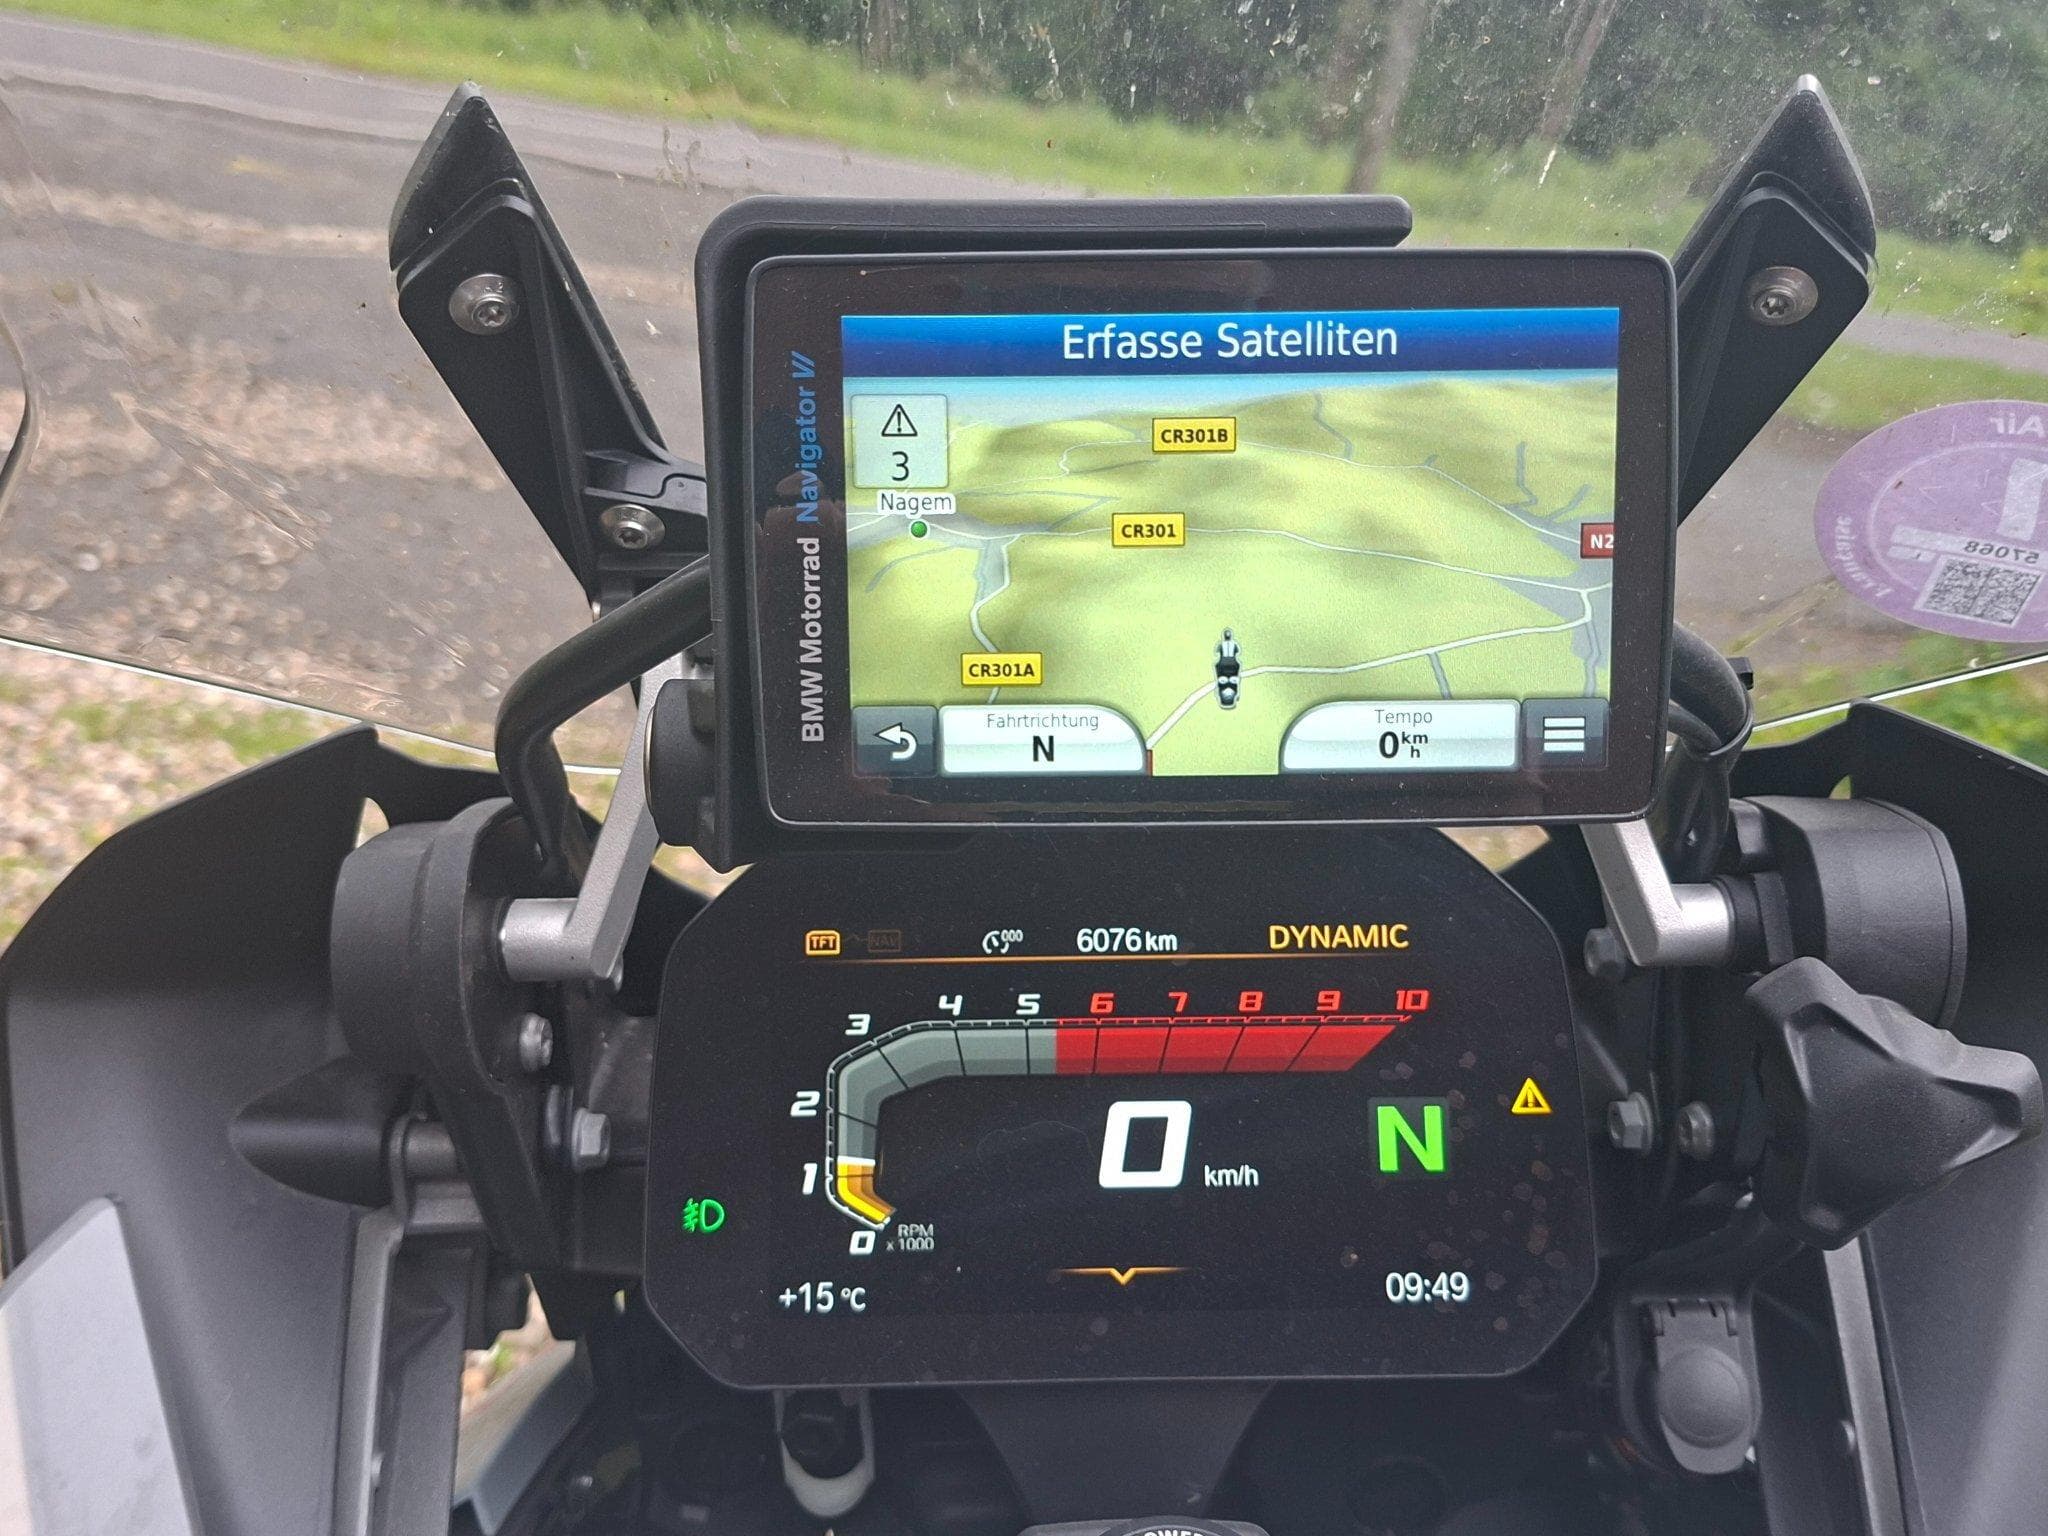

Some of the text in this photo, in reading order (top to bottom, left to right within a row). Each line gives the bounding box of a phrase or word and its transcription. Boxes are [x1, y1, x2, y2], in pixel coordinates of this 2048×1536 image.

[1063, 320, 1399, 362] Erfasse Satelliten
[1159, 426, 1229, 446] CR301B
[795, 385, 822, 523] Navigator
[892, 450, 910, 482] 3
[881, 493, 952, 515] Nagem
[1120, 521, 1177, 540] CR301
[797, 536, 823, 665] Motorrad
[967, 661, 1036, 680] CR301A
[800, 670, 825, 743] BMW
[1374, 709, 1433, 727] Tempo
[987, 713, 1099, 731] Fahrtrichtung
[1032, 735, 1055, 762] N
[1379, 731, 1399, 758] 0
[811, 936, 836, 950] TFT
[1076, 928, 1178, 952] 6076 km
[1268, 924, 1410, 950] DYNAMIC
[938, 995, 963, 1017] 4
[1015, 994, 1041, 1015] 5
[1089, 993, 1116, 1014] 6
[1168, 992, 1189, 1013] 7
[1237, 992, 1264, 1012] 8
[1315, 991, 1342, 1012] 9
[1394, 989, 1431, 1013] 10
[845, 1014, 872, 1037] 3
[790, 1091, 820, 1117] 2
[1098, 1100, 1193, 1188] 0
[1377, 1105, 1445, 1173] N
[801, 1163, 817, 1195] 1
[1203, 1164, 1259, 1189] km/h
[898, 1224, 934, 1237] RPM
[849, 1230, 876, 1256] 0
[898, 1237, 935, 1251] 1000
[778, 1281, 834, 1314] +15
[1384, 1272, 1471, 1304] 09:49
